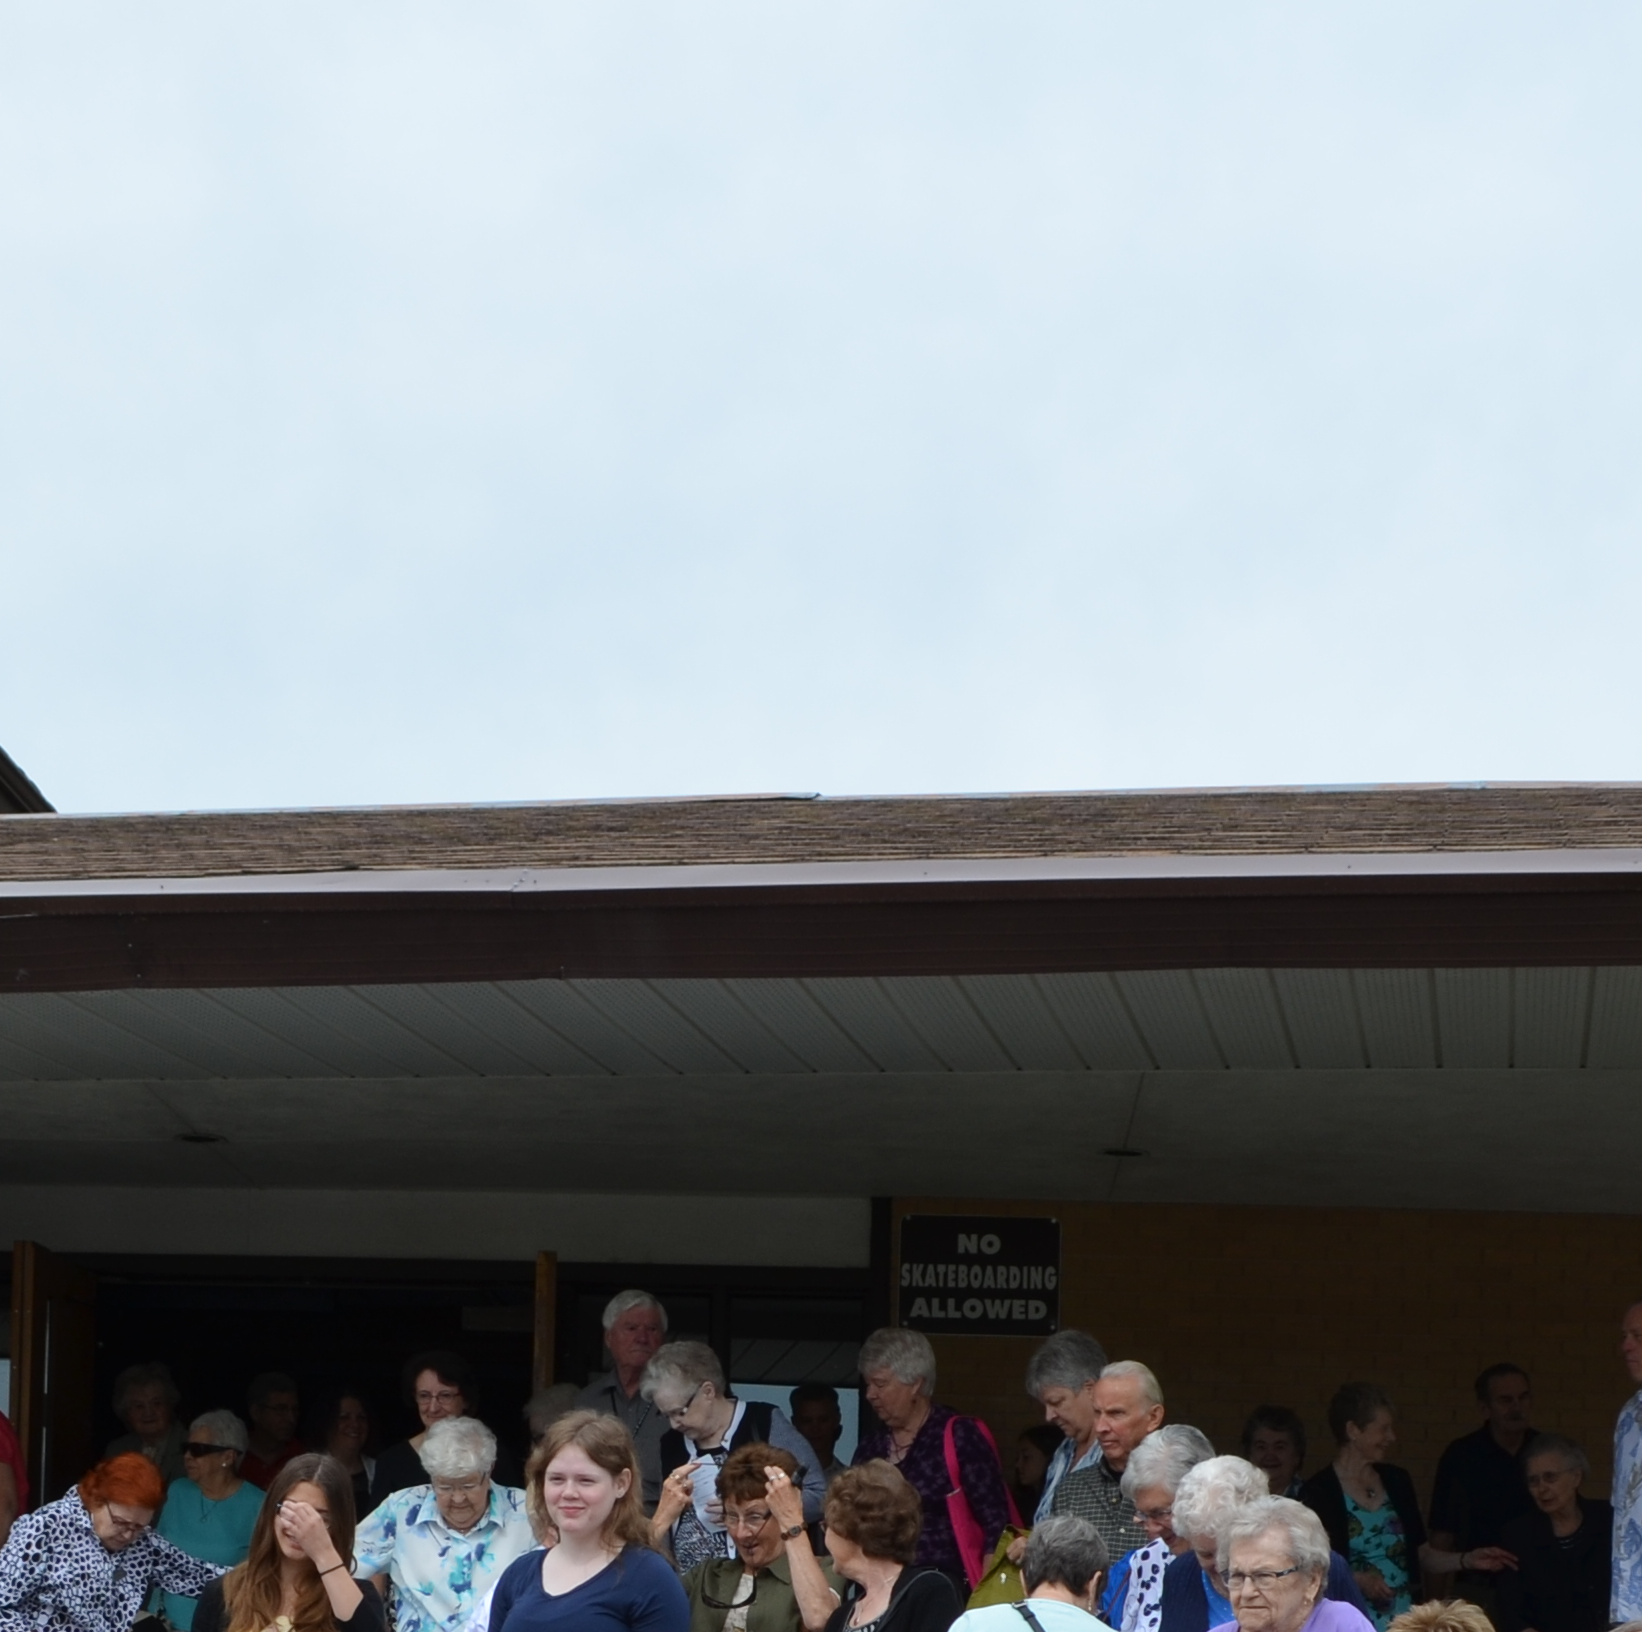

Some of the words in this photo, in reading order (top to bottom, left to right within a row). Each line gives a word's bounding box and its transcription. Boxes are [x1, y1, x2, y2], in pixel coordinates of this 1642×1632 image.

[958, 1233, 1001, 1255] NO
[900, 1263, 1057, 1290] SKATEBOARDING
[909, 1297, 1048, 1320] ALLOWED
